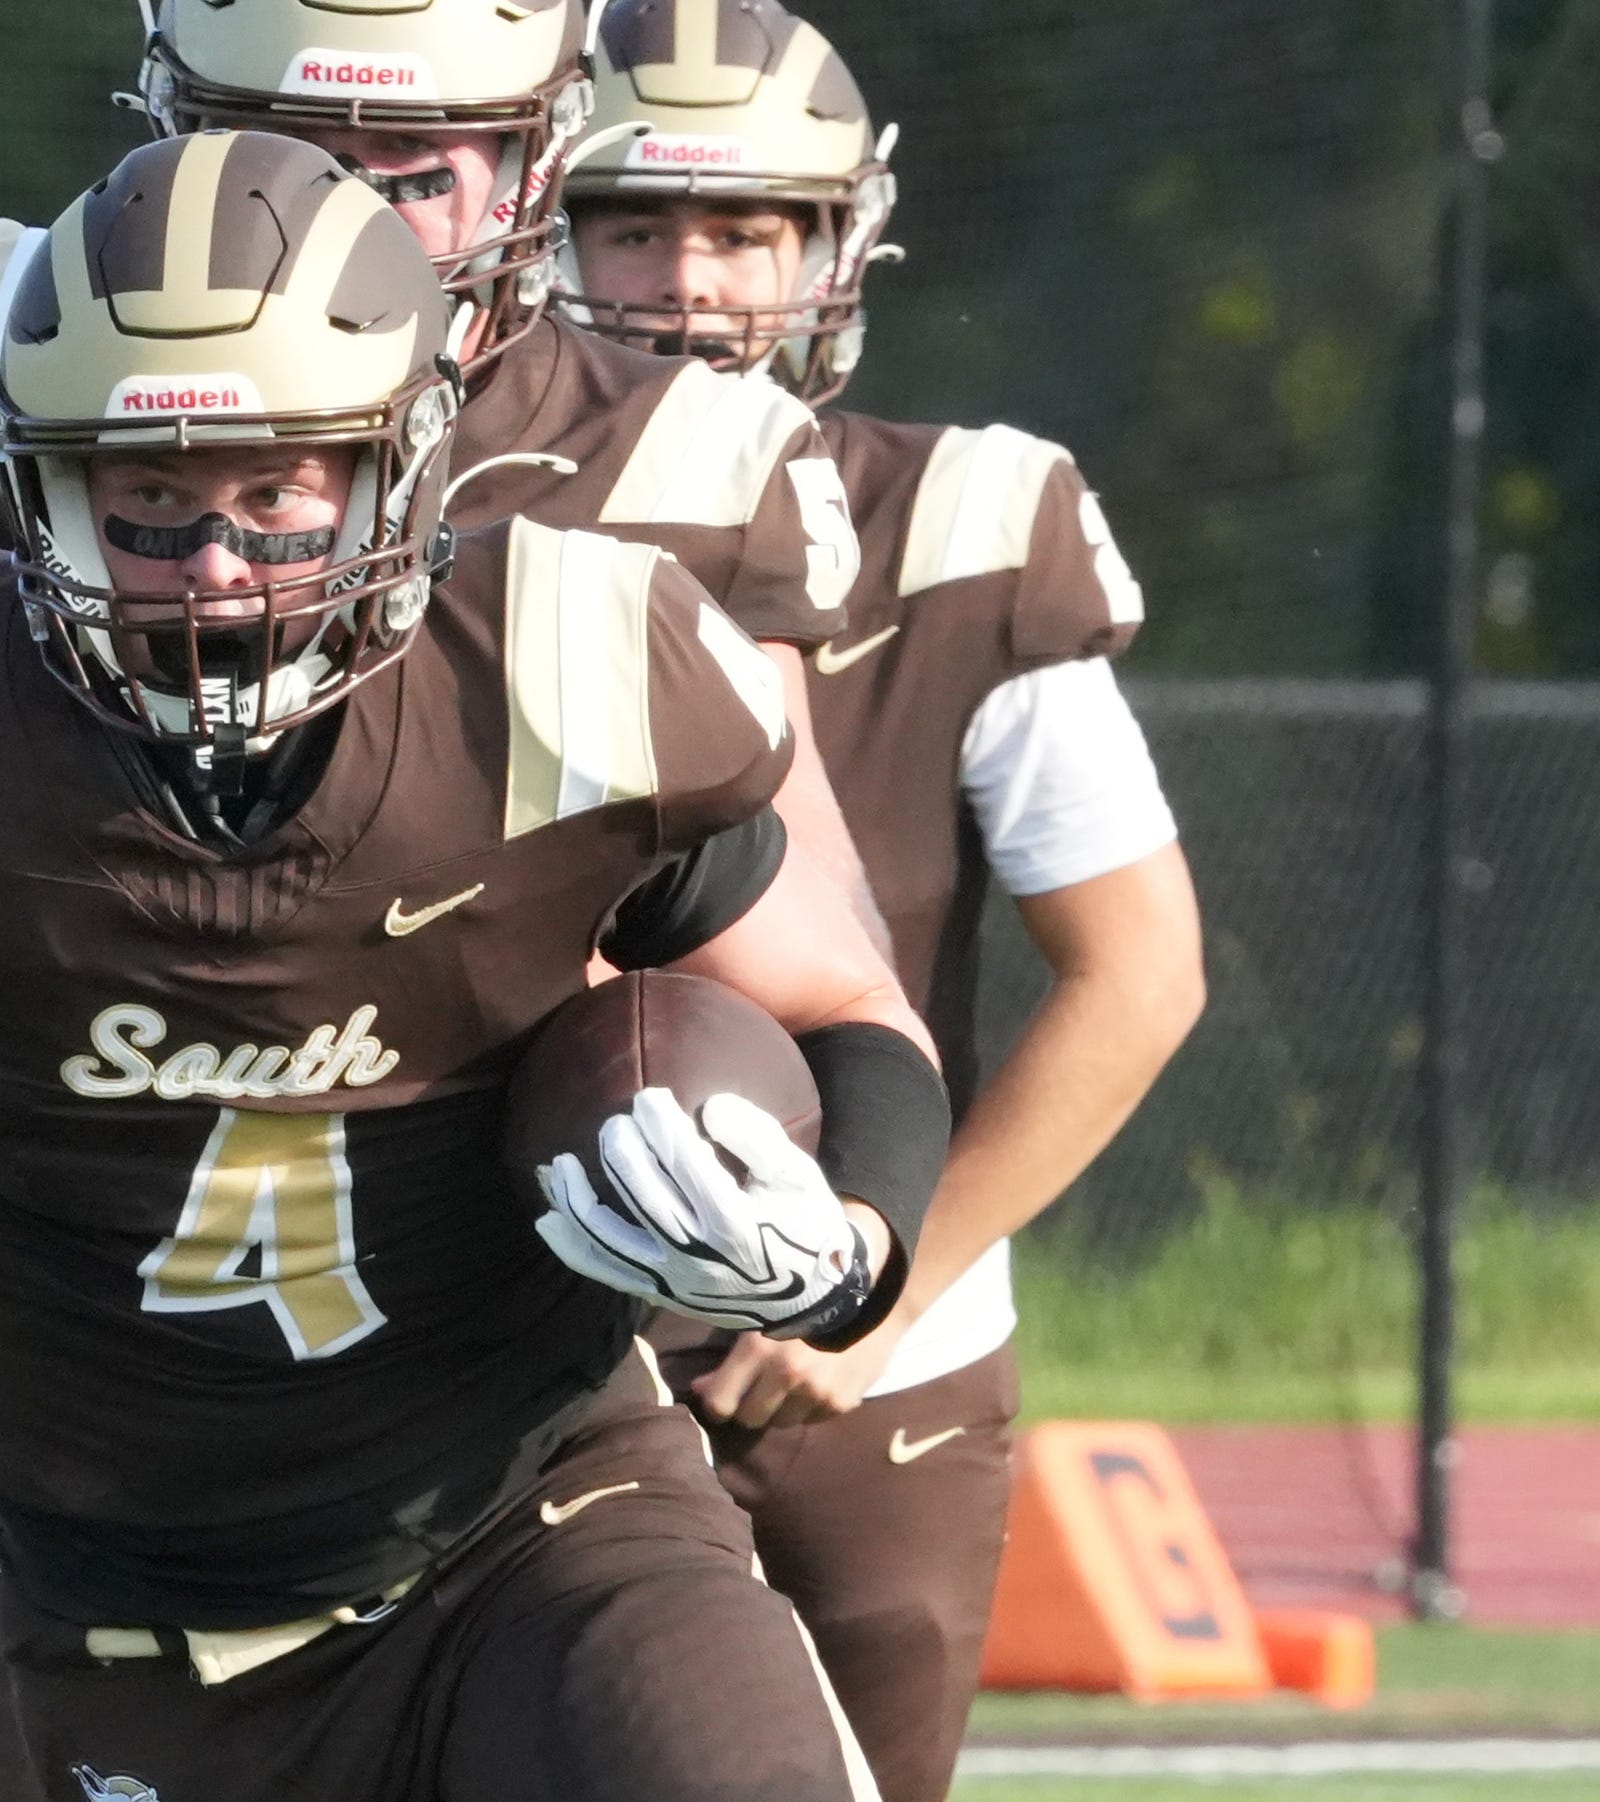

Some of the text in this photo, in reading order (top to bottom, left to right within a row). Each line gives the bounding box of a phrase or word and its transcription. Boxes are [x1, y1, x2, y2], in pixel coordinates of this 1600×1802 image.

[302, 61, 415, 85] Riddell
[643, 142, 741, 163] Riddell
[123, 387, 239, 411] Riddell
[60, 1003, 400, 1100] South
[137, 1108, 388, 1361] 4
